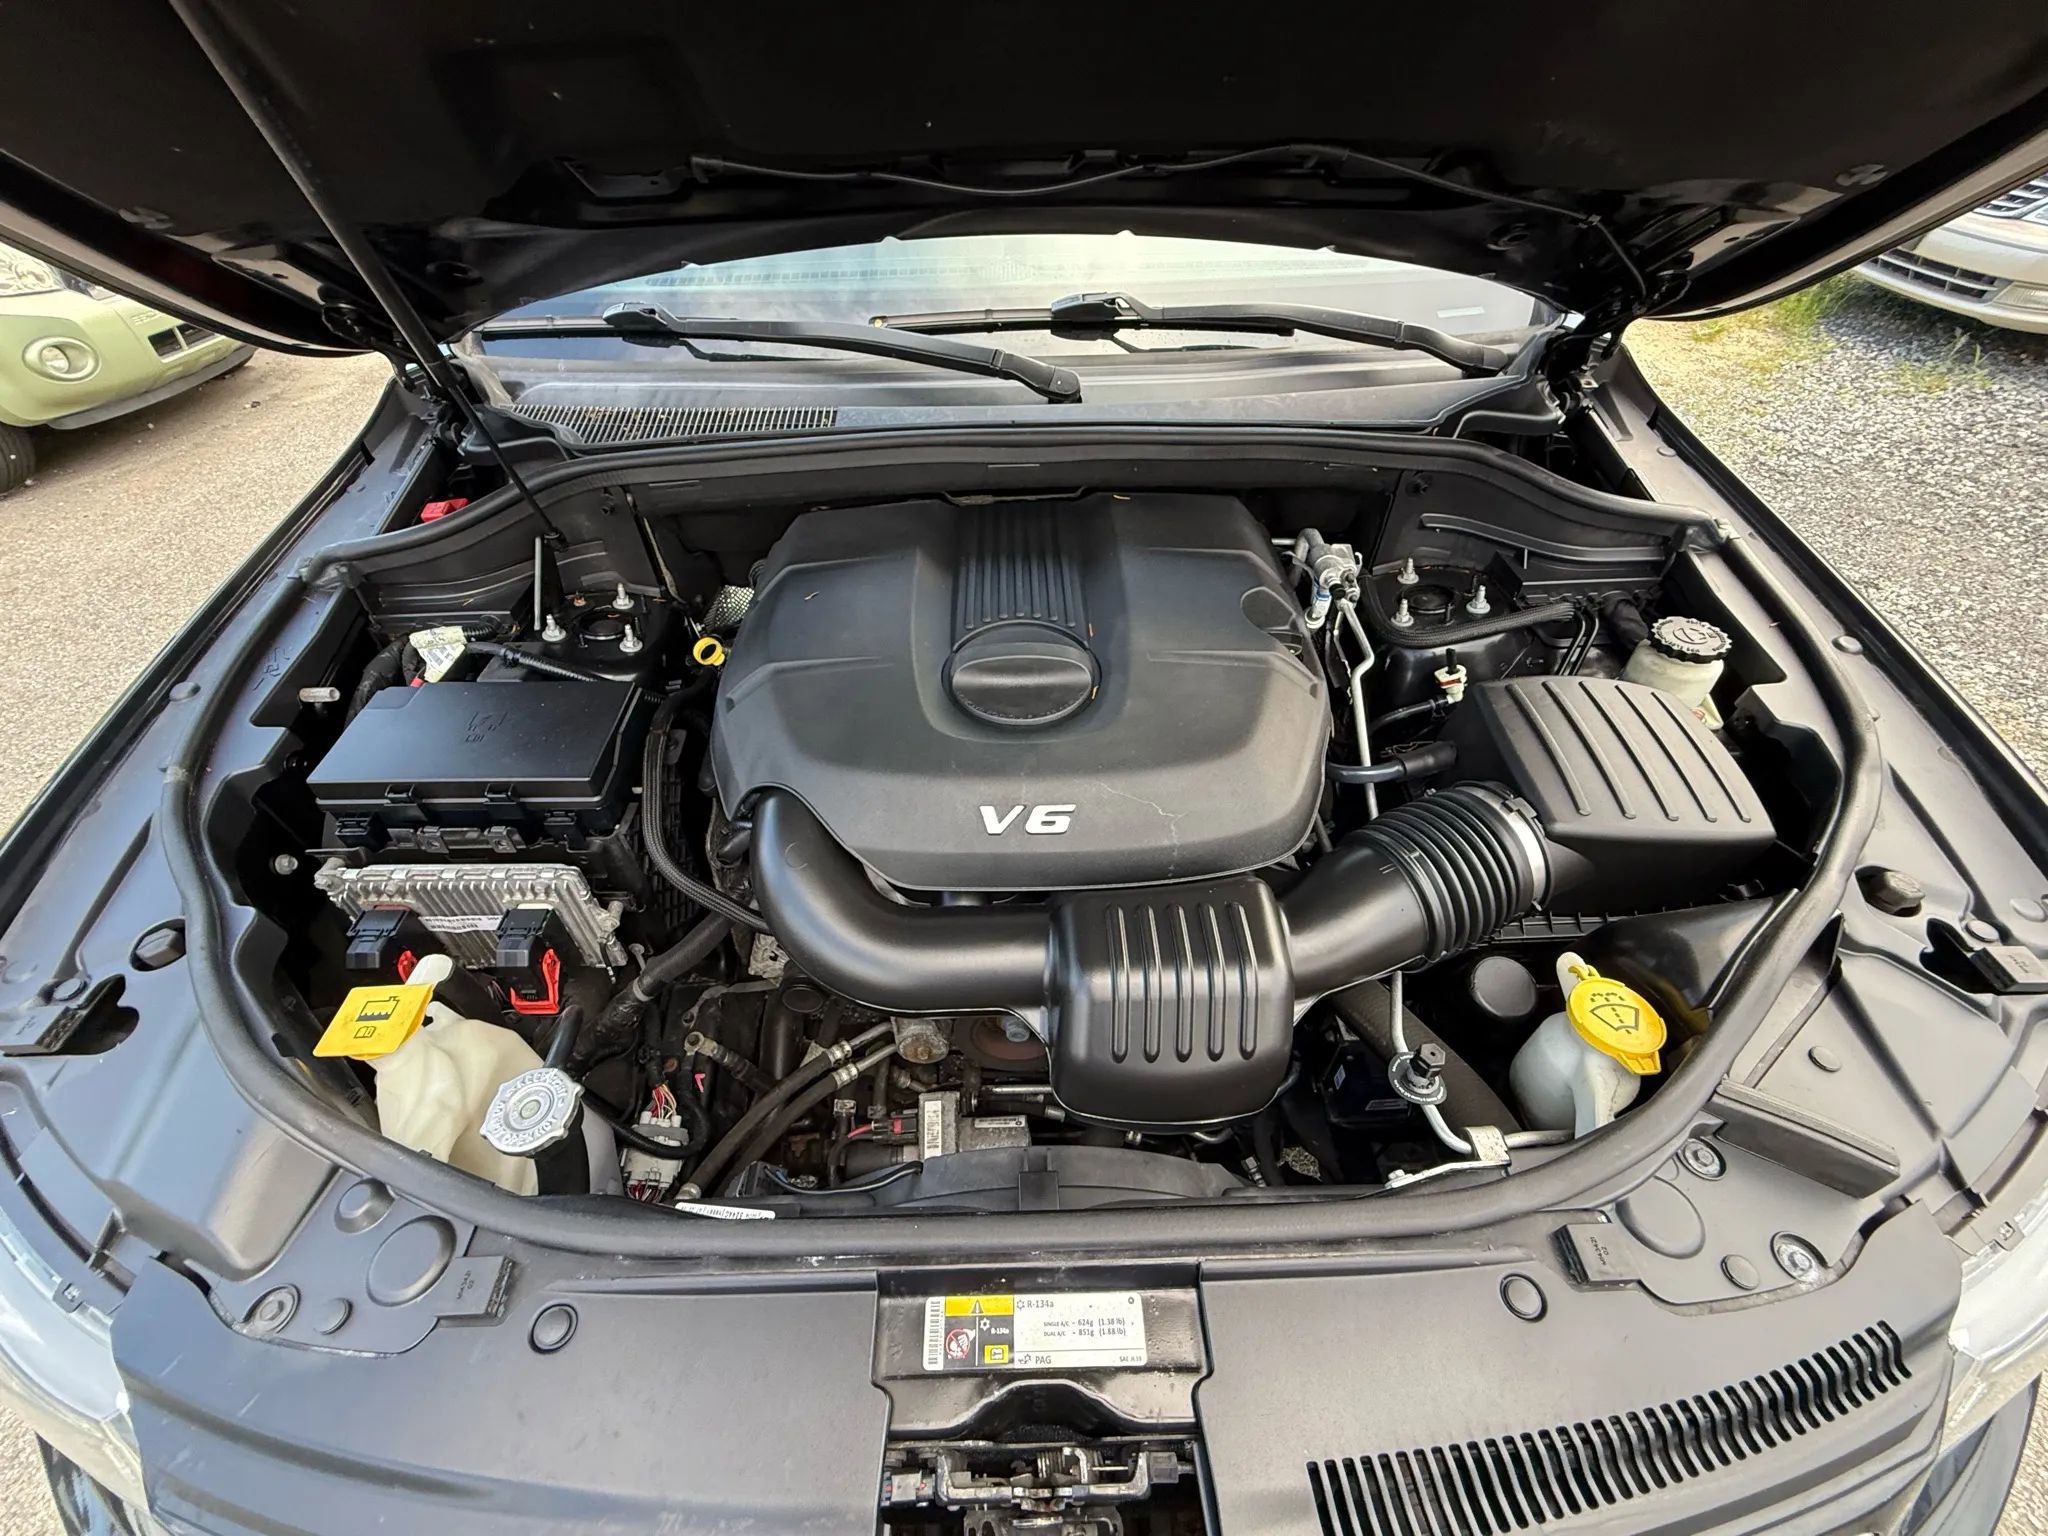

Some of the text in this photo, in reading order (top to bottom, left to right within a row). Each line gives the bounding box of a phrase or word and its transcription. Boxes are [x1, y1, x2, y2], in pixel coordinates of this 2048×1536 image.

[979, 804, 1076, 834] V6
[1027, 1299, 1055, 1309] R-134a
[1078, 1318, 1094, 1327] 624g
[1078, 1328, 1095, 1337] 851g
[1035, 1355, 1052, 1365] PAG
